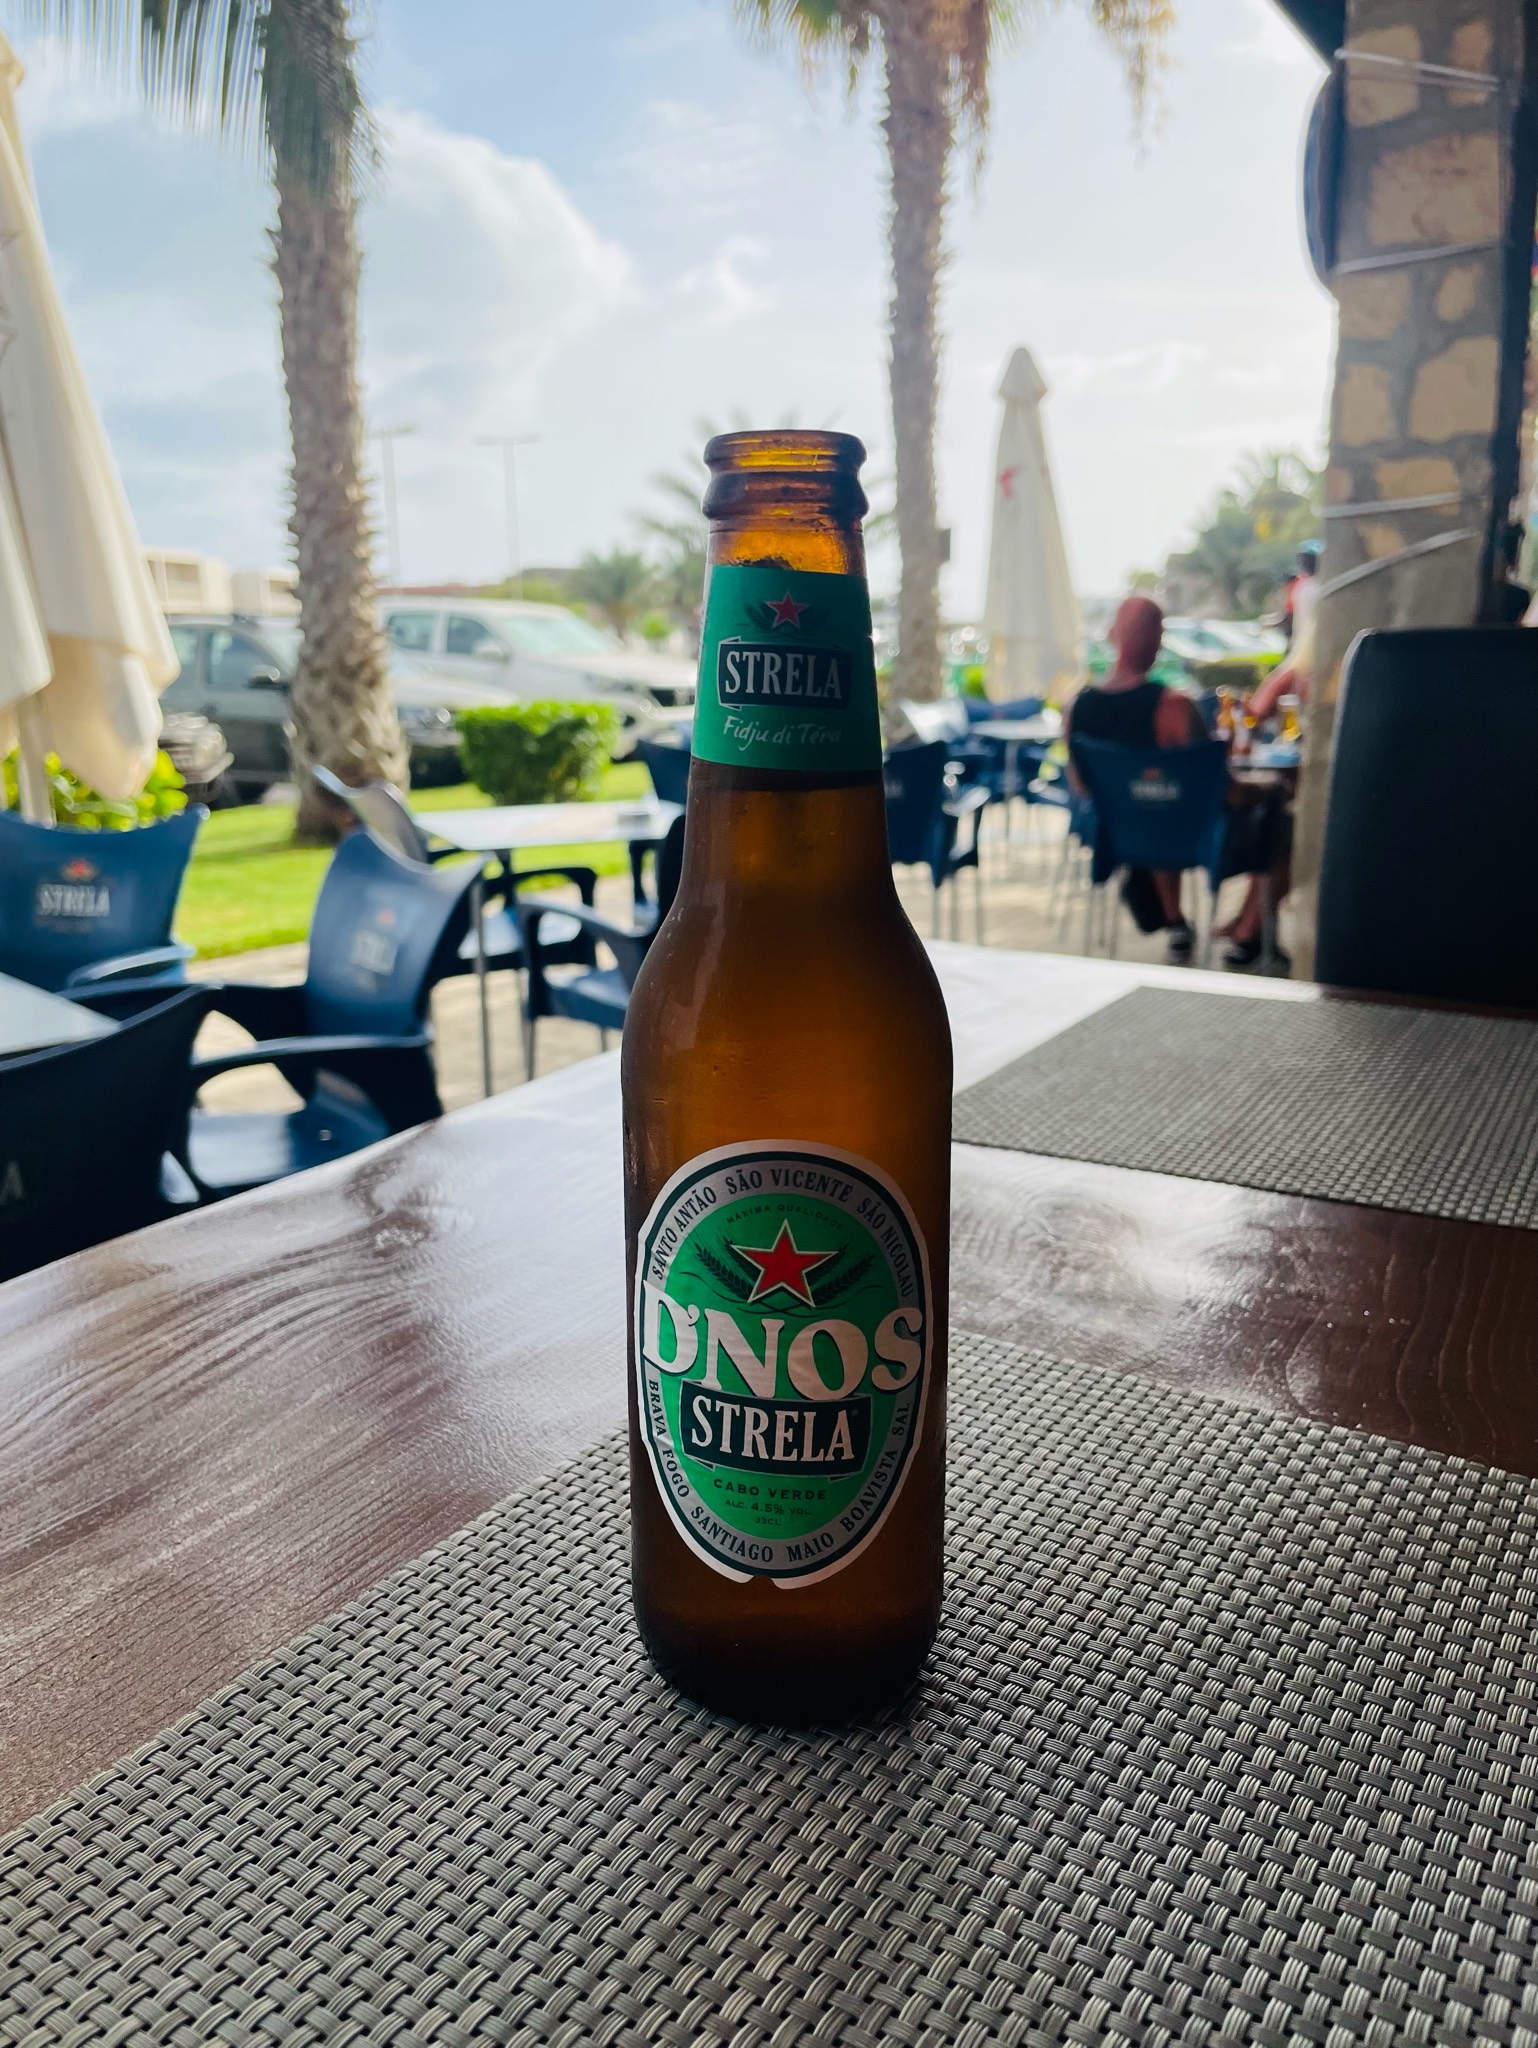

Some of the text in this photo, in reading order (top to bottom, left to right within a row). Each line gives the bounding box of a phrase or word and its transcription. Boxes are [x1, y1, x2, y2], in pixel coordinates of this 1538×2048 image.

[725, 650, 842, 699] STRELA
[723, 715, 769, 751] Fidju
[772, 724, 795, 744] di
[651, 1168, 914, 1298] SANTO ANTÃO SÃO VICENTE SÃO NICOLAU
[690, 1394, 856, 1463] STRELA
[648, 1379, 910, 1563] BRAVA FOGO SANTIAGO MAIO BOAVISTA SAL
[713, 1478, 828, 1500] CABO VERDE
[751, 1502, 785, 1516] 4.5%
